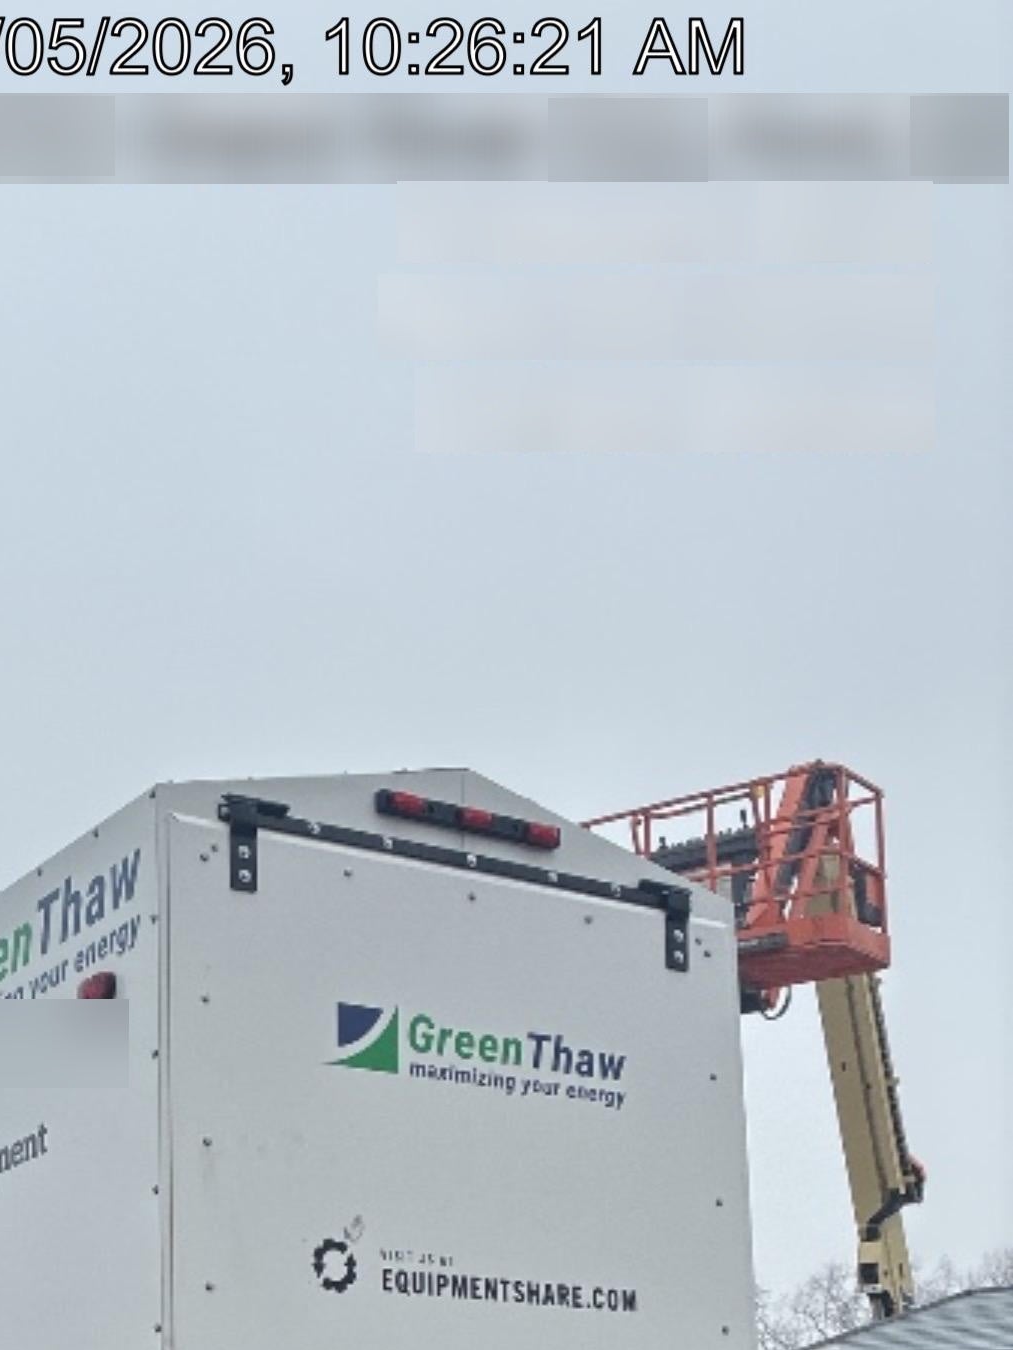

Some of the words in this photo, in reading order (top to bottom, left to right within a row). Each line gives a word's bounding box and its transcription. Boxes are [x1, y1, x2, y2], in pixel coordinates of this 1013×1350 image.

[74, 914, 141, 974] energy
[409, 1061, 517, 1096] maximizing
[520, 1080, 561, 1097] your
[565, 1085, 627, 1111] energy
[382, 1268, 638, 1312] EQUIPMENTSHARE.COM
